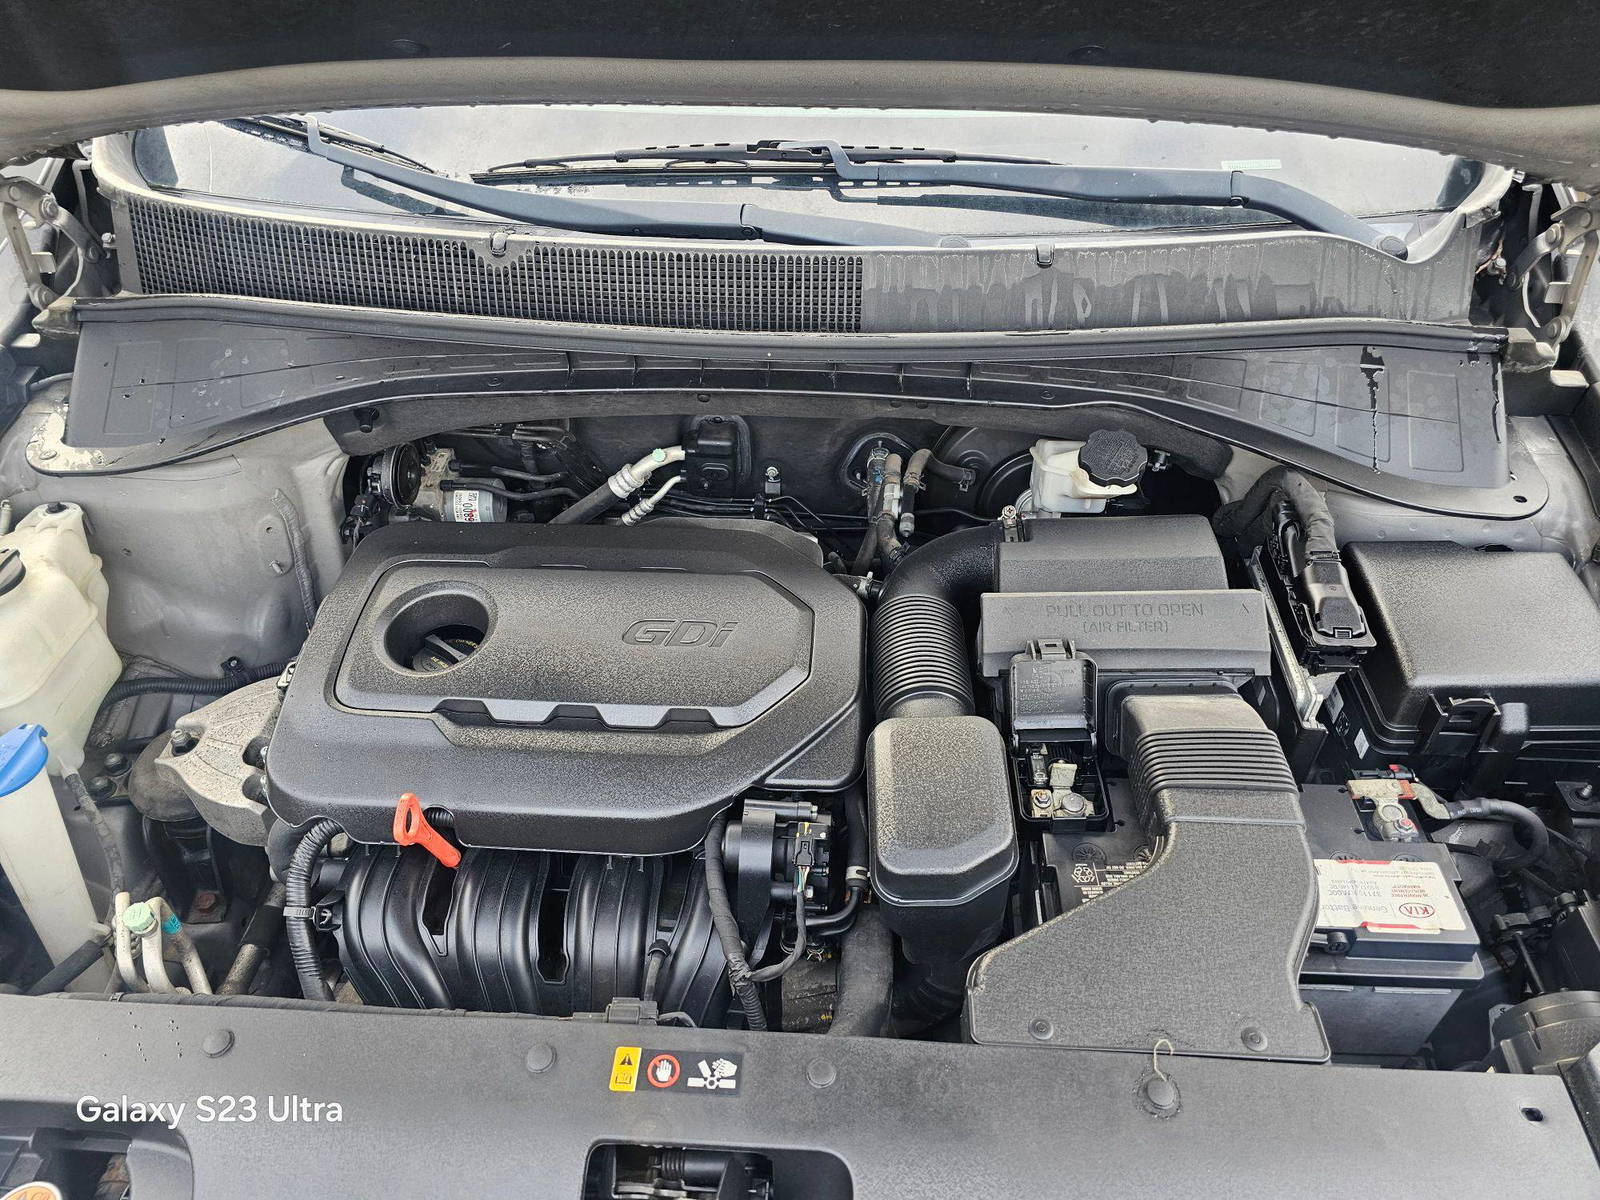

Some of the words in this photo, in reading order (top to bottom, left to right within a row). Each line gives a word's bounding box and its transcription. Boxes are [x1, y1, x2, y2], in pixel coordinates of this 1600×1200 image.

[1046, 604, 1082, 618] PULL
[1092, 603, 1127, 617] OUT
[1134, 603, 1153, 617] TO
[1158, 602, 1204, 617] OPEN
[621, 618, 739, 648] GDi
[1083, 621, 1112, 634] (AIR
[1116, 620, 1169, 634] FILTER)
[1404, 906, 1430, 916] KIA
